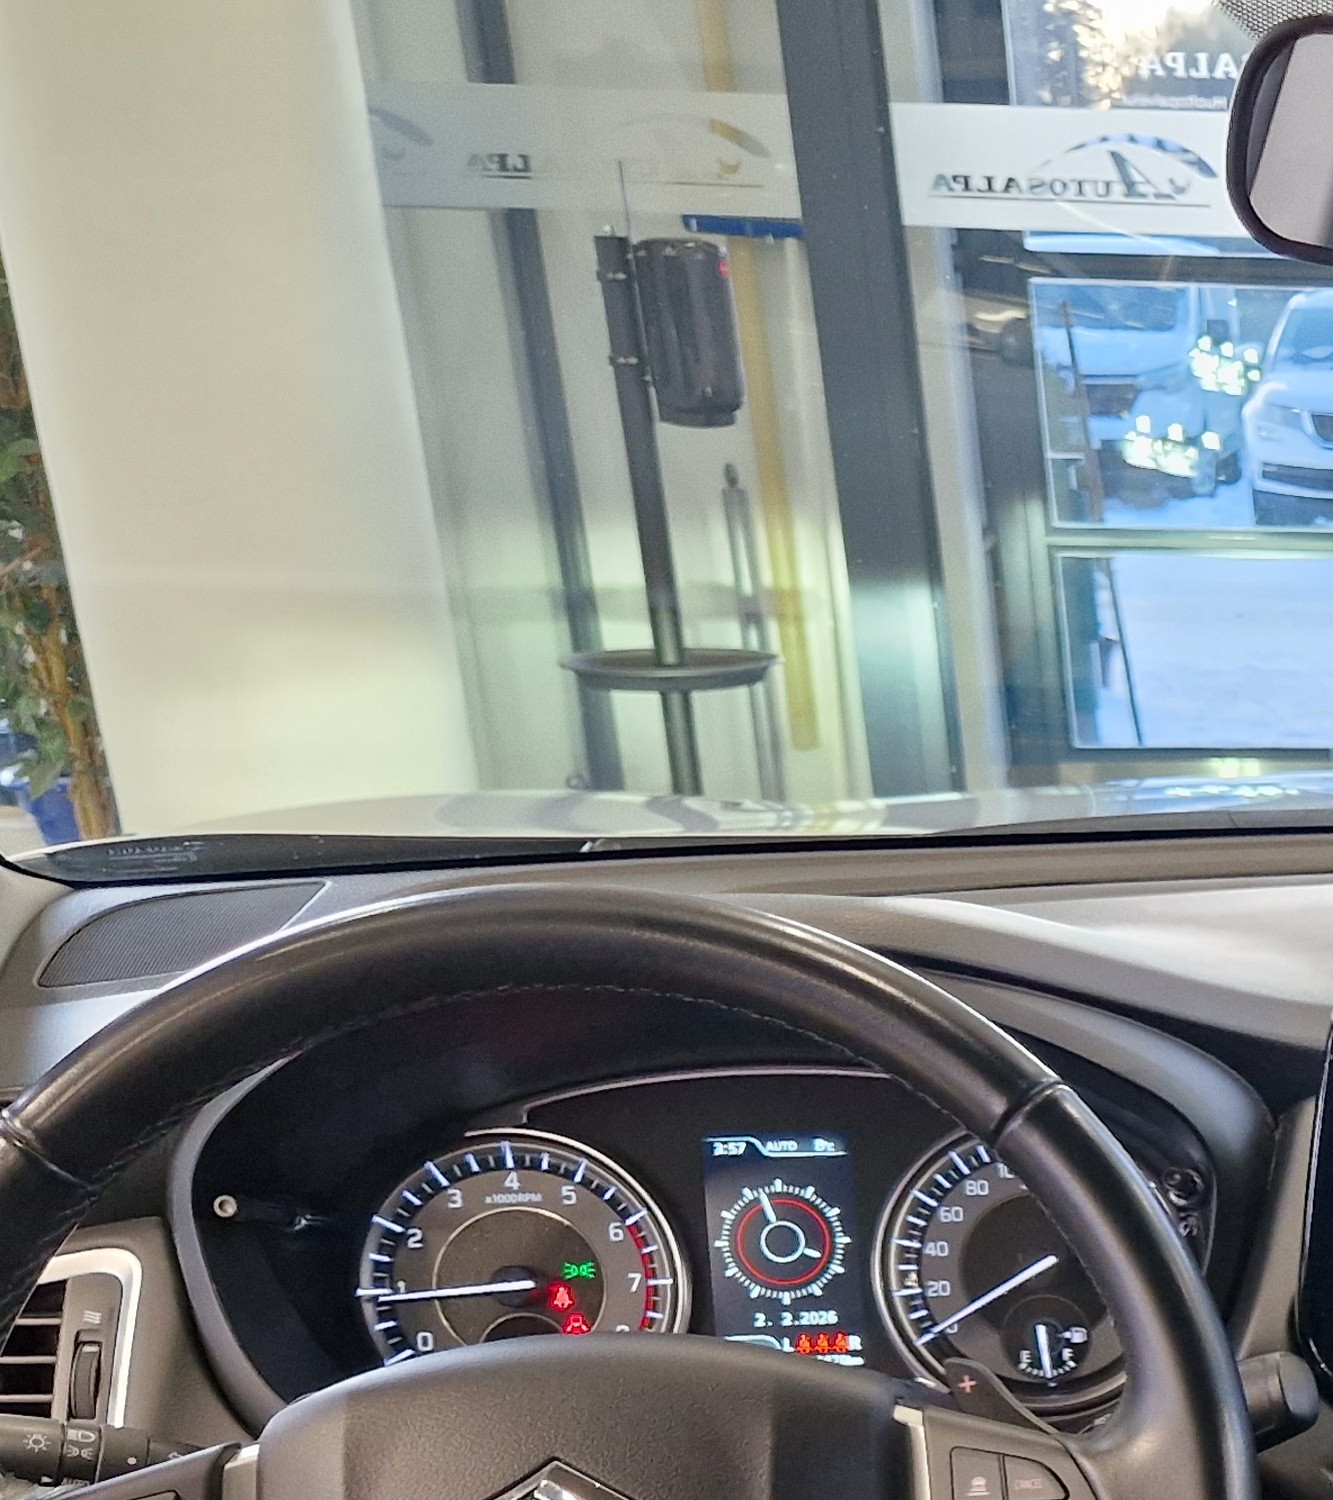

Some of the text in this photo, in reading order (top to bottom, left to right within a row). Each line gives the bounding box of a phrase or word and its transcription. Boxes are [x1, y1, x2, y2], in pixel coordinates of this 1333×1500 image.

[765, 1140, 798, 1151] AUTO
[503, 1171, 521, 1190] 4
[965, 1179, 989, 1196] 80
[447, 1188, 463, 1208] 3
[561, 1185, 577, 1205] 5
[940, 1207, 964, 1222] 60
[406, 1227, 424, 1248] 2
[608, 1222, 624, 1241] 6
[924, 1243, 949, 1257] 40
[627, 1273, 643, 1292] 7
[927, 1281, 950, 1297] 20
[416, 1331, 434, 1351] 0
[1020, 1351, 1031, 1362] E
[1063, 1348, 1074, 1360] F
[1014, 1478, 1043, 1490] CANCEL
